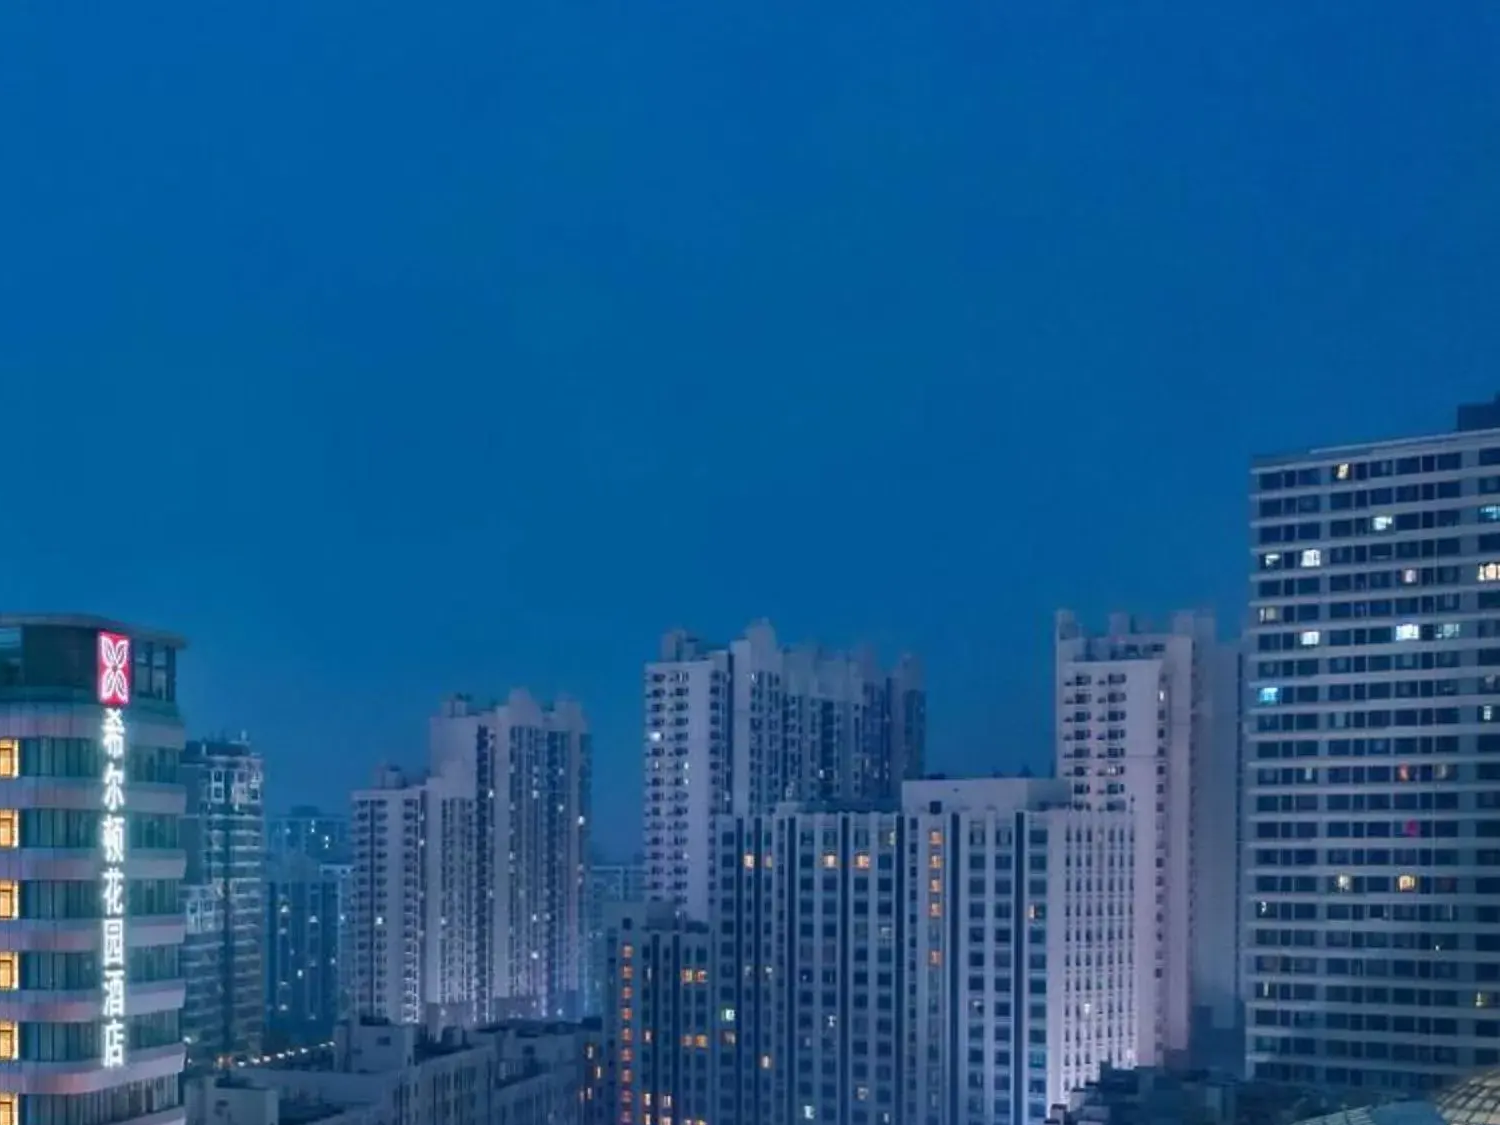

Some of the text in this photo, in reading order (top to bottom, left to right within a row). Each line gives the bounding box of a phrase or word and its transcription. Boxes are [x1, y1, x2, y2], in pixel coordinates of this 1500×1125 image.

[102, 707, 125, 1069] 希尔顿花园酒店
